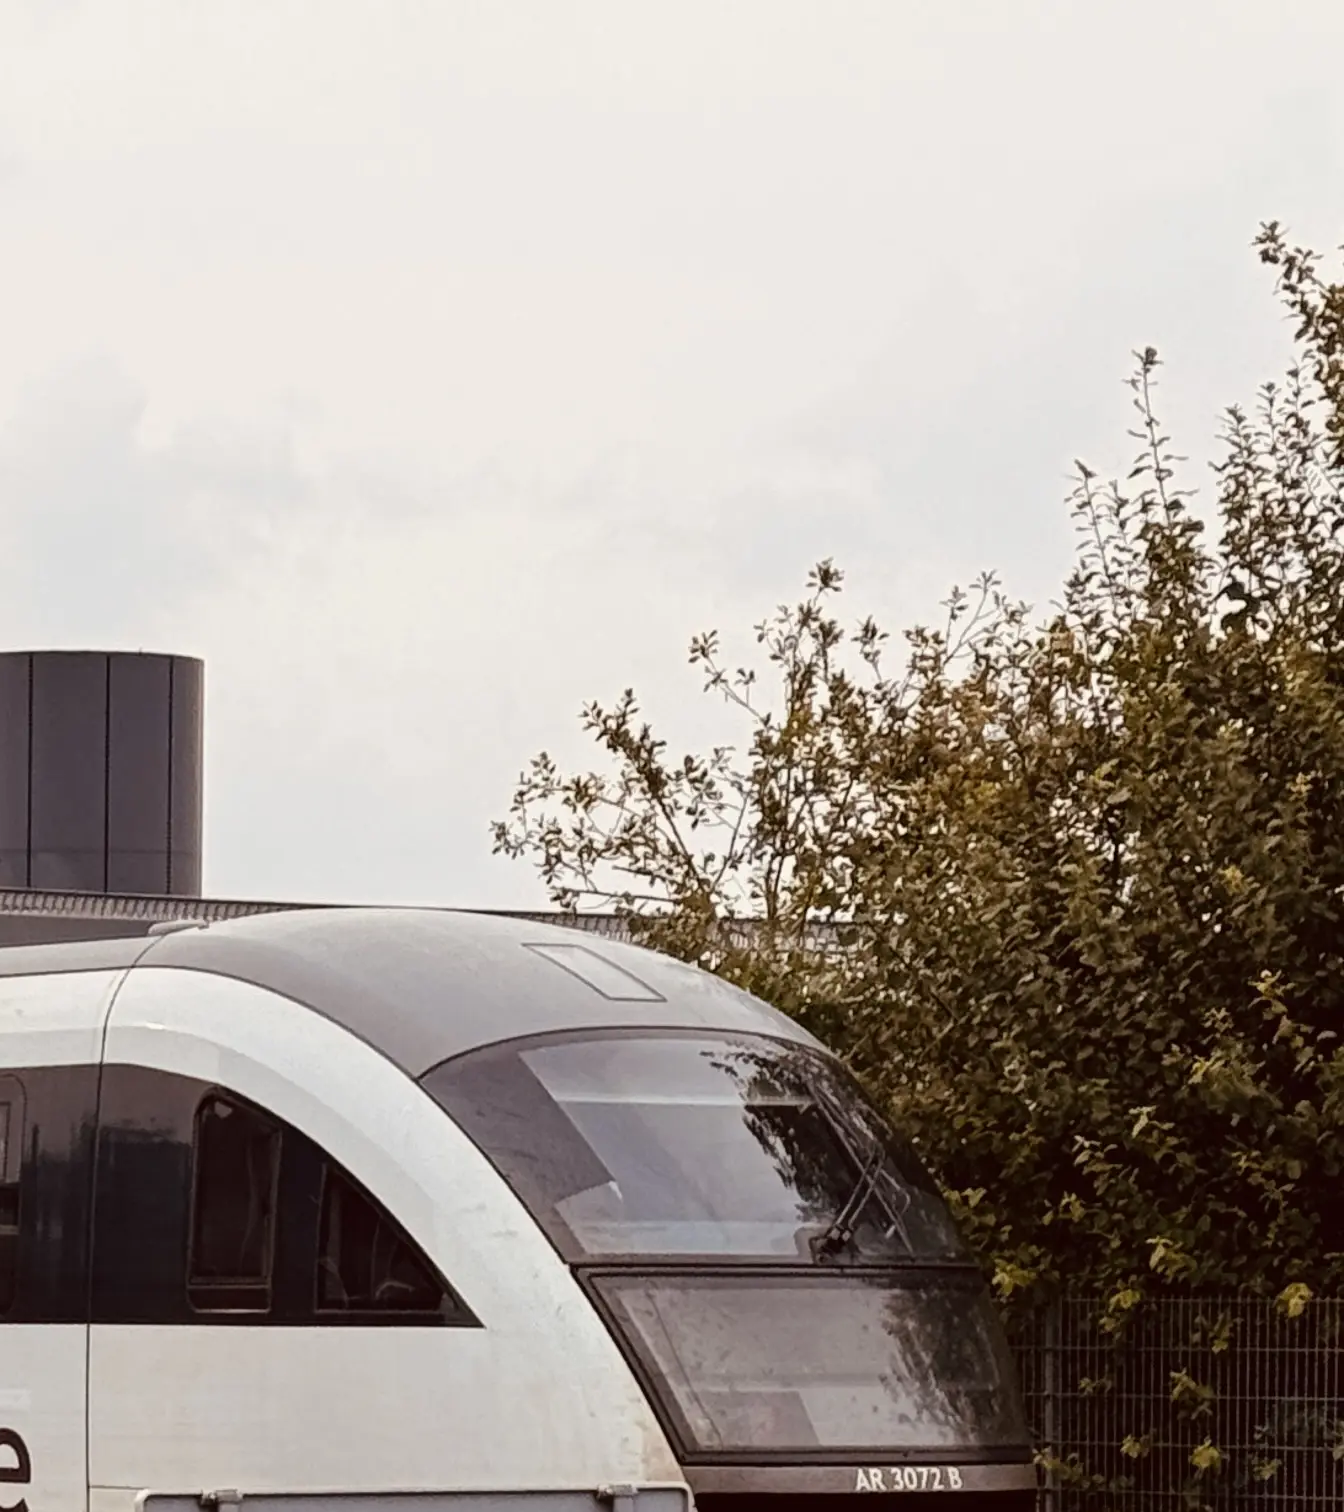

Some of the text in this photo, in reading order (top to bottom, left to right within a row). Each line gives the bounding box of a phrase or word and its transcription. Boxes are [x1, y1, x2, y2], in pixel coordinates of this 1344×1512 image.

[855, 1466, 963, 1491] AR 3072 B
